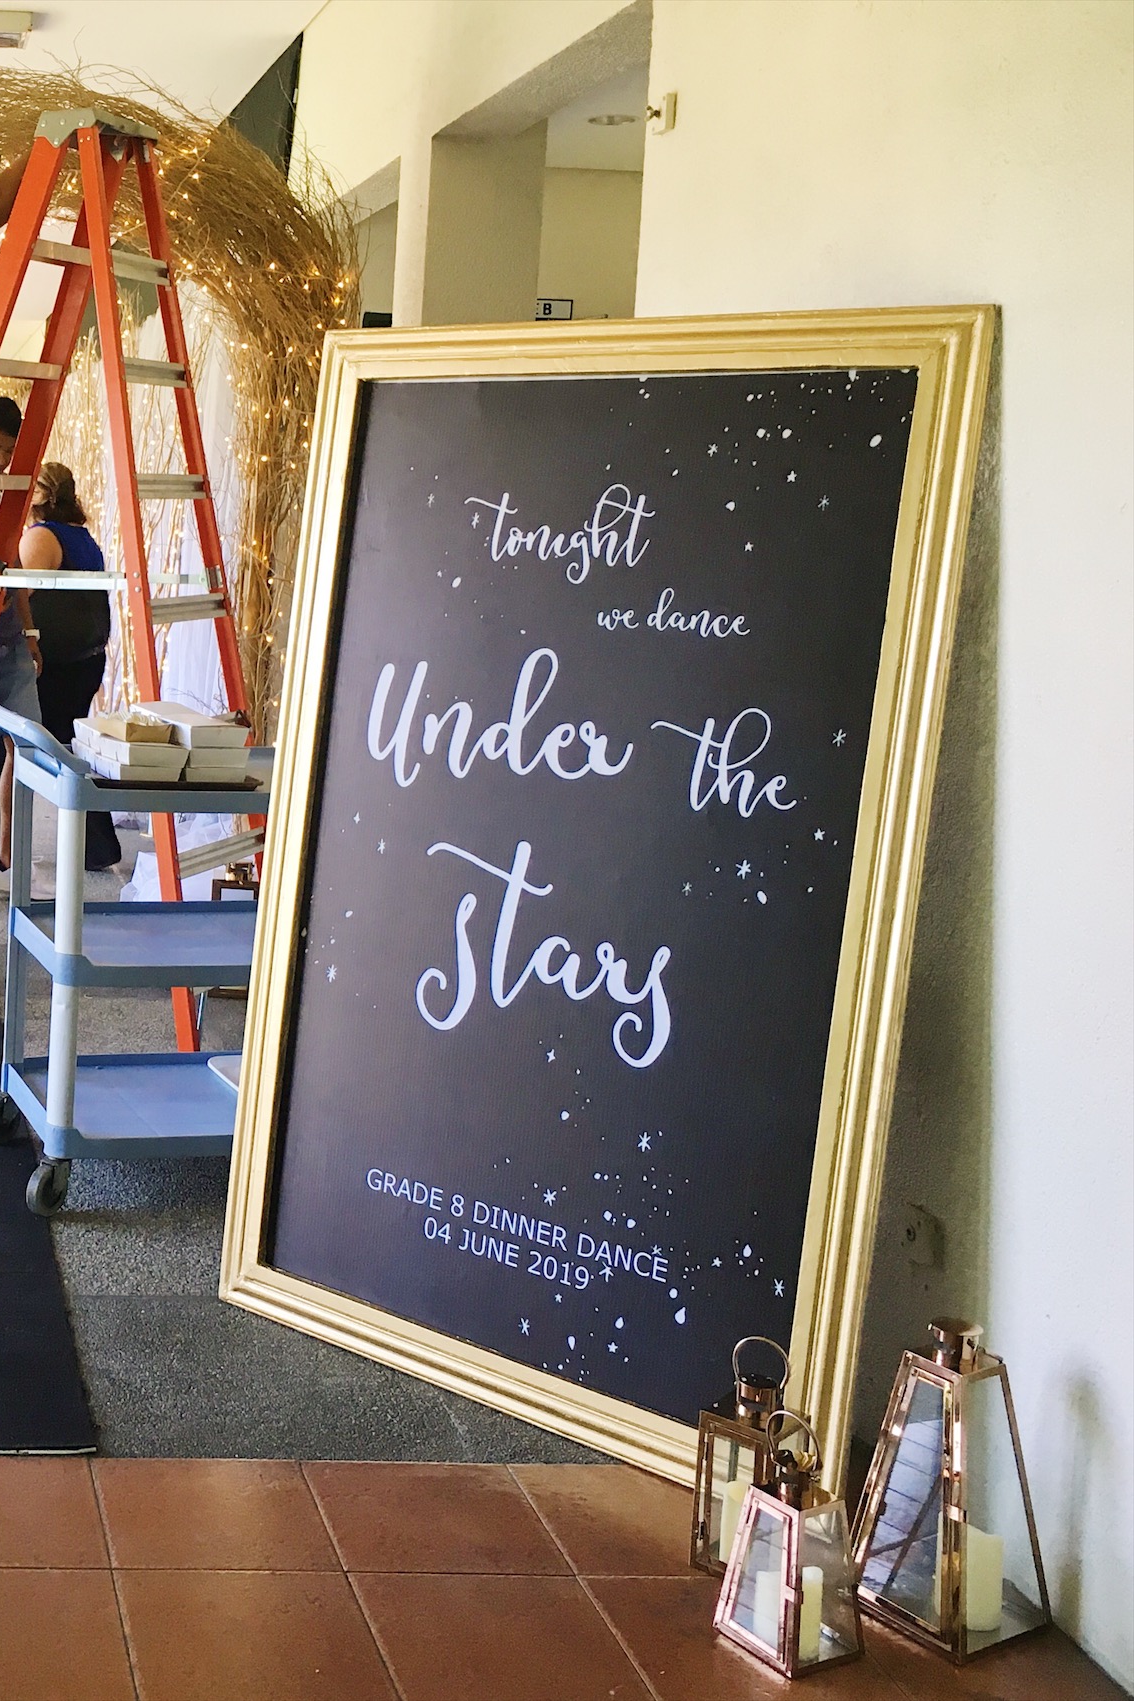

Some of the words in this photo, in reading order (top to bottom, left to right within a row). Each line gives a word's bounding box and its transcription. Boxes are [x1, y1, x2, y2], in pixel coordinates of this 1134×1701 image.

[543, 302, 552, 315] B
[464, 484, 655, 584] tonight
[597, 608, 640, 630] we
[646, 588, 750, 638] dance
[367, 647, 633, 788] Under
[651, 708, 797, 818] the
[366, 1168, 444, 1211] GRADE
[450, 1194, 465, 1218] 8
[472, 1200, 568, 1252] DINNER
[577, 1233, 669, 1283] DANCE
[424, 1216, 452, 1245] 04
[458, 1228, 520, 1268] JUNE
[527, 1250, 590, 1290] 2019
